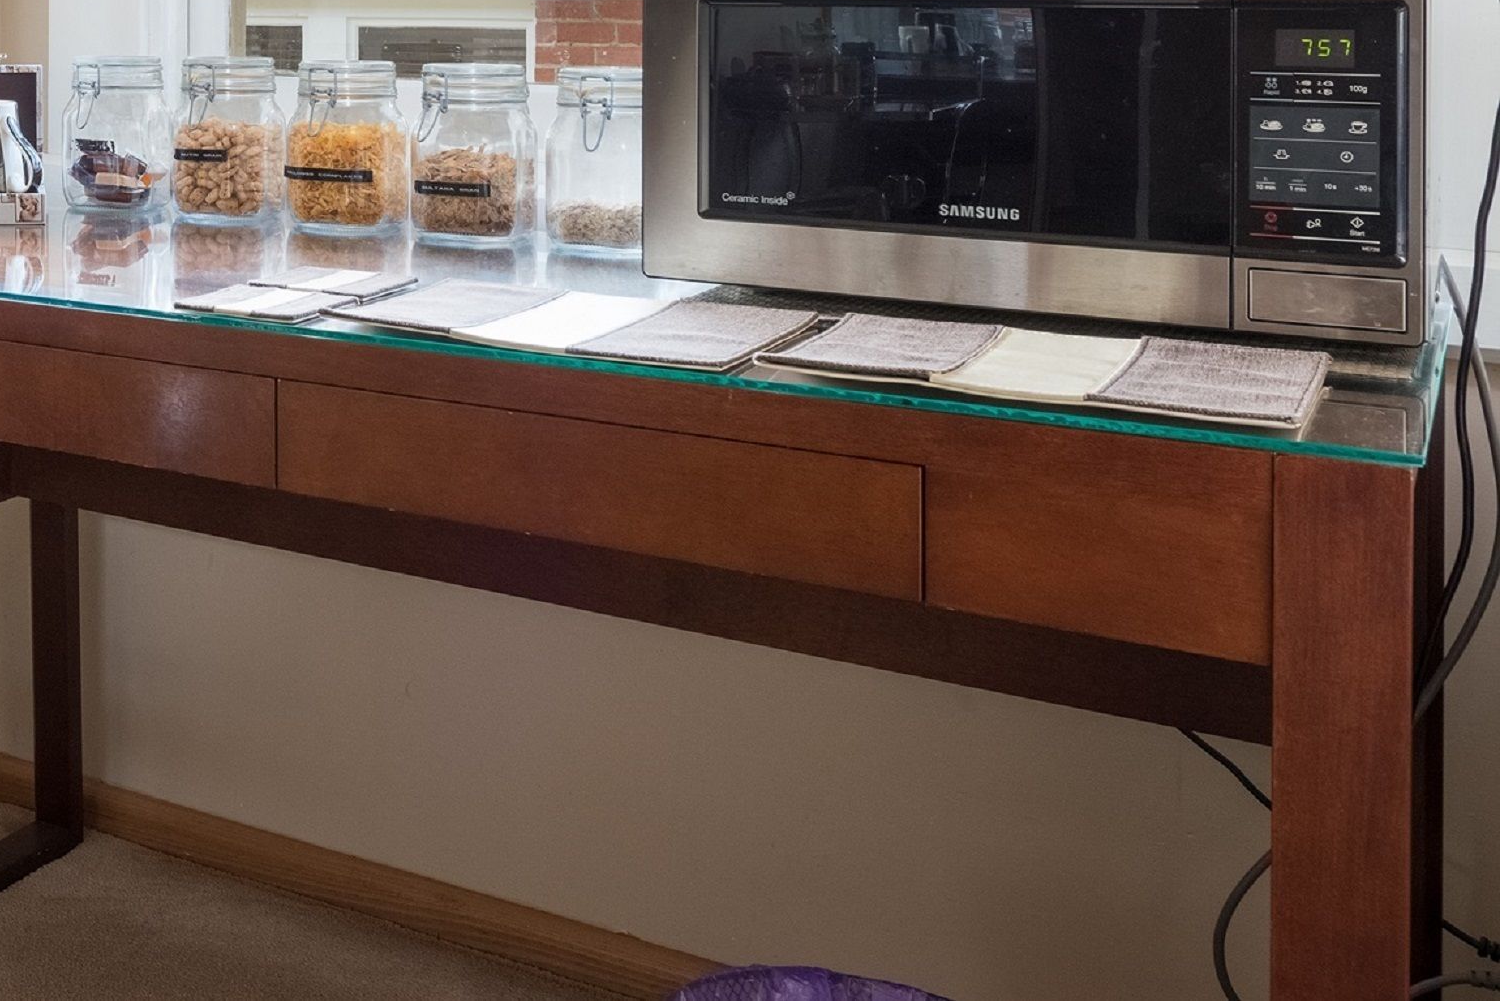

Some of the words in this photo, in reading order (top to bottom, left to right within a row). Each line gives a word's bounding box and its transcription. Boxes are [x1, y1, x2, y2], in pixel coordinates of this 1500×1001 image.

[722, 193, 758, 204] Ceramic
[761, 195, 788, 206] Inside
[938, 204, 1020, 221] SAMSUNG
